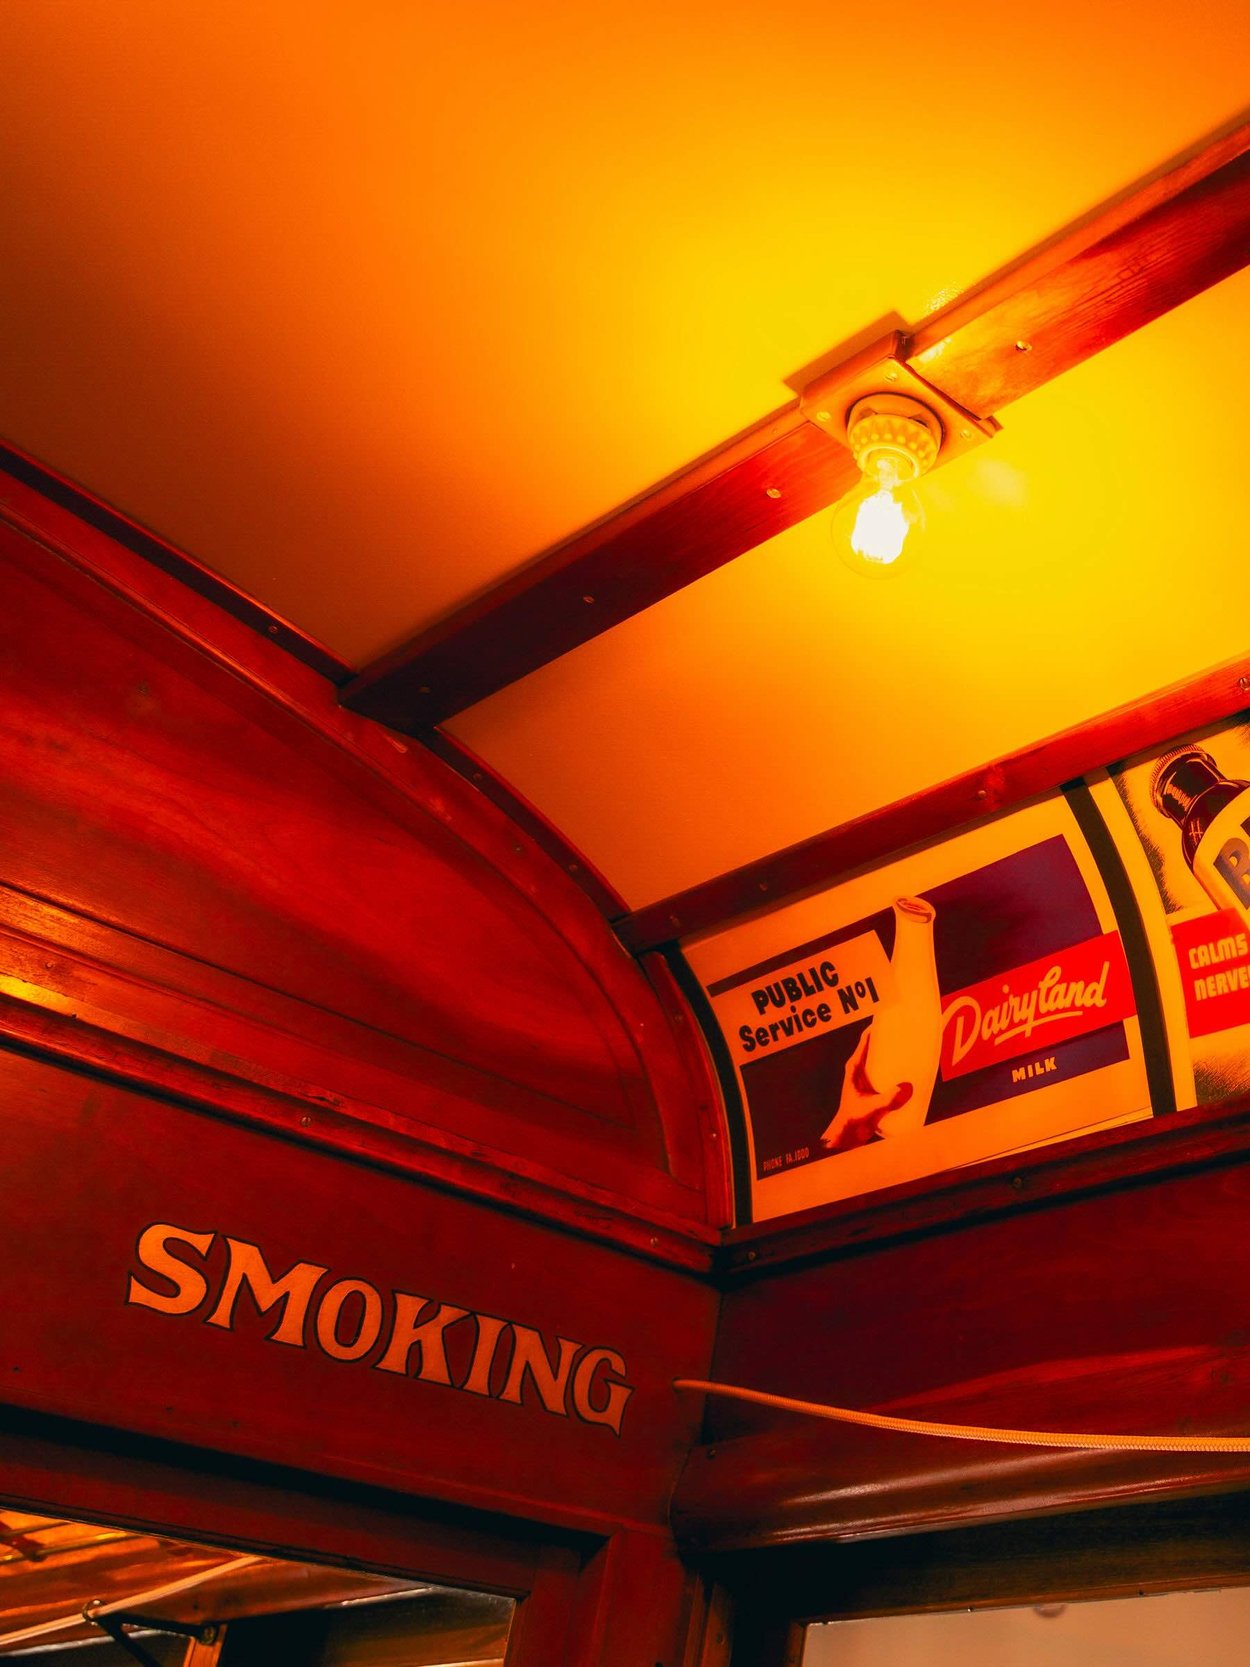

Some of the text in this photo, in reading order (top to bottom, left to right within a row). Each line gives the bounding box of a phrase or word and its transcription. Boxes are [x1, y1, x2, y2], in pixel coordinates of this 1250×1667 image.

[1188, 933, 1249, 970] CALMS
[751, 960, 840, 1016] PUBLIC
[941, 961, 1111, 1066] Dairyland
[738, 1003, 832, 1053] Service
[1012, 1056, 1057, 1083] MILK
[125, 1222, 636, 1438] SMOKING
